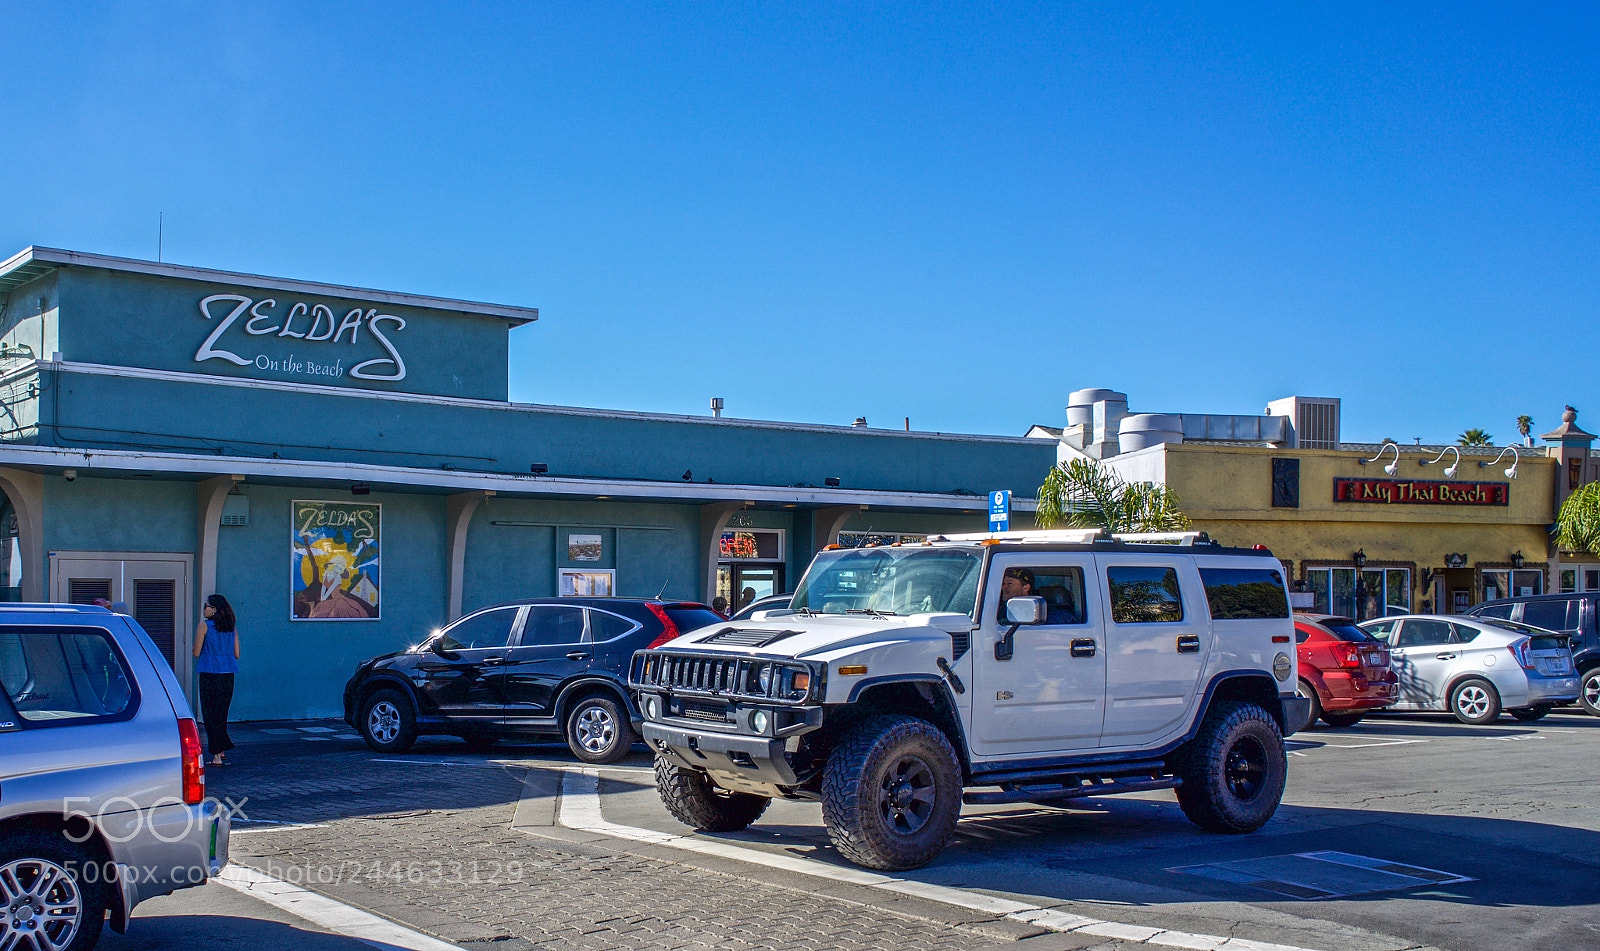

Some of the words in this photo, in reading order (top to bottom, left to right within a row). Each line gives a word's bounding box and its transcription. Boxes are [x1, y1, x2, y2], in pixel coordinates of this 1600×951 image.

[194, 293, 407, 382] ZELDA'S
[255, 354, 278, 371] On
[282, 354, 303, 373] the
[306, 358, 344, 378] Beach
[1363, 483, 1391, 504] My
[1396, 482, 1434, 501] Thai
[1438, 484, 1486, 502] Beach
[298, 507, 374, 538] ZELDA'S
[719, 537, 753, 555] OPEN
